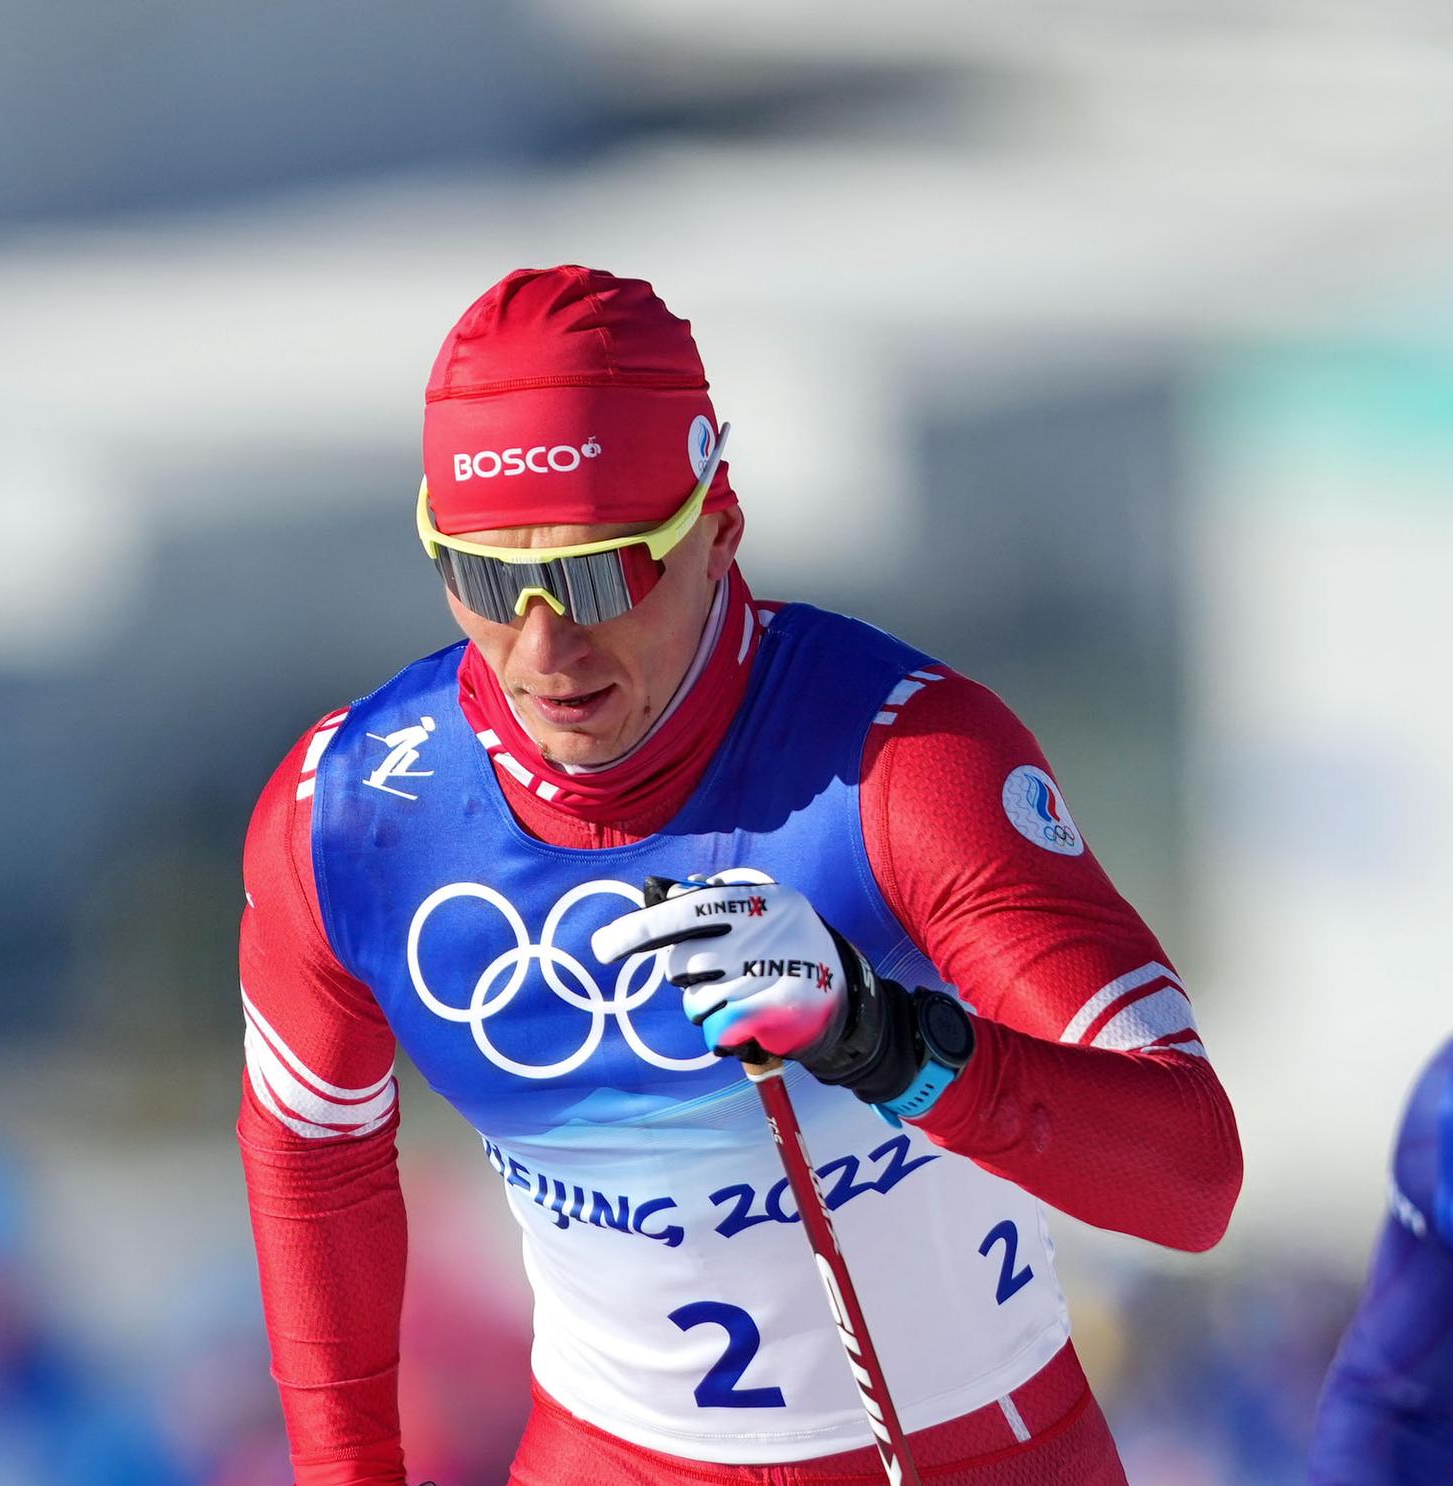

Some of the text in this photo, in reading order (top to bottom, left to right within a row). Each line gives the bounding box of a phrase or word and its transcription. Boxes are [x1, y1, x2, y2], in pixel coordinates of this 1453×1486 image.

[453, 444, 581, 482] BOSCO
[708, 1133, 941, 1239] 2022
[979, 1219, 1034, 1305] 2
[667, 1300, 786, 1408] 2
